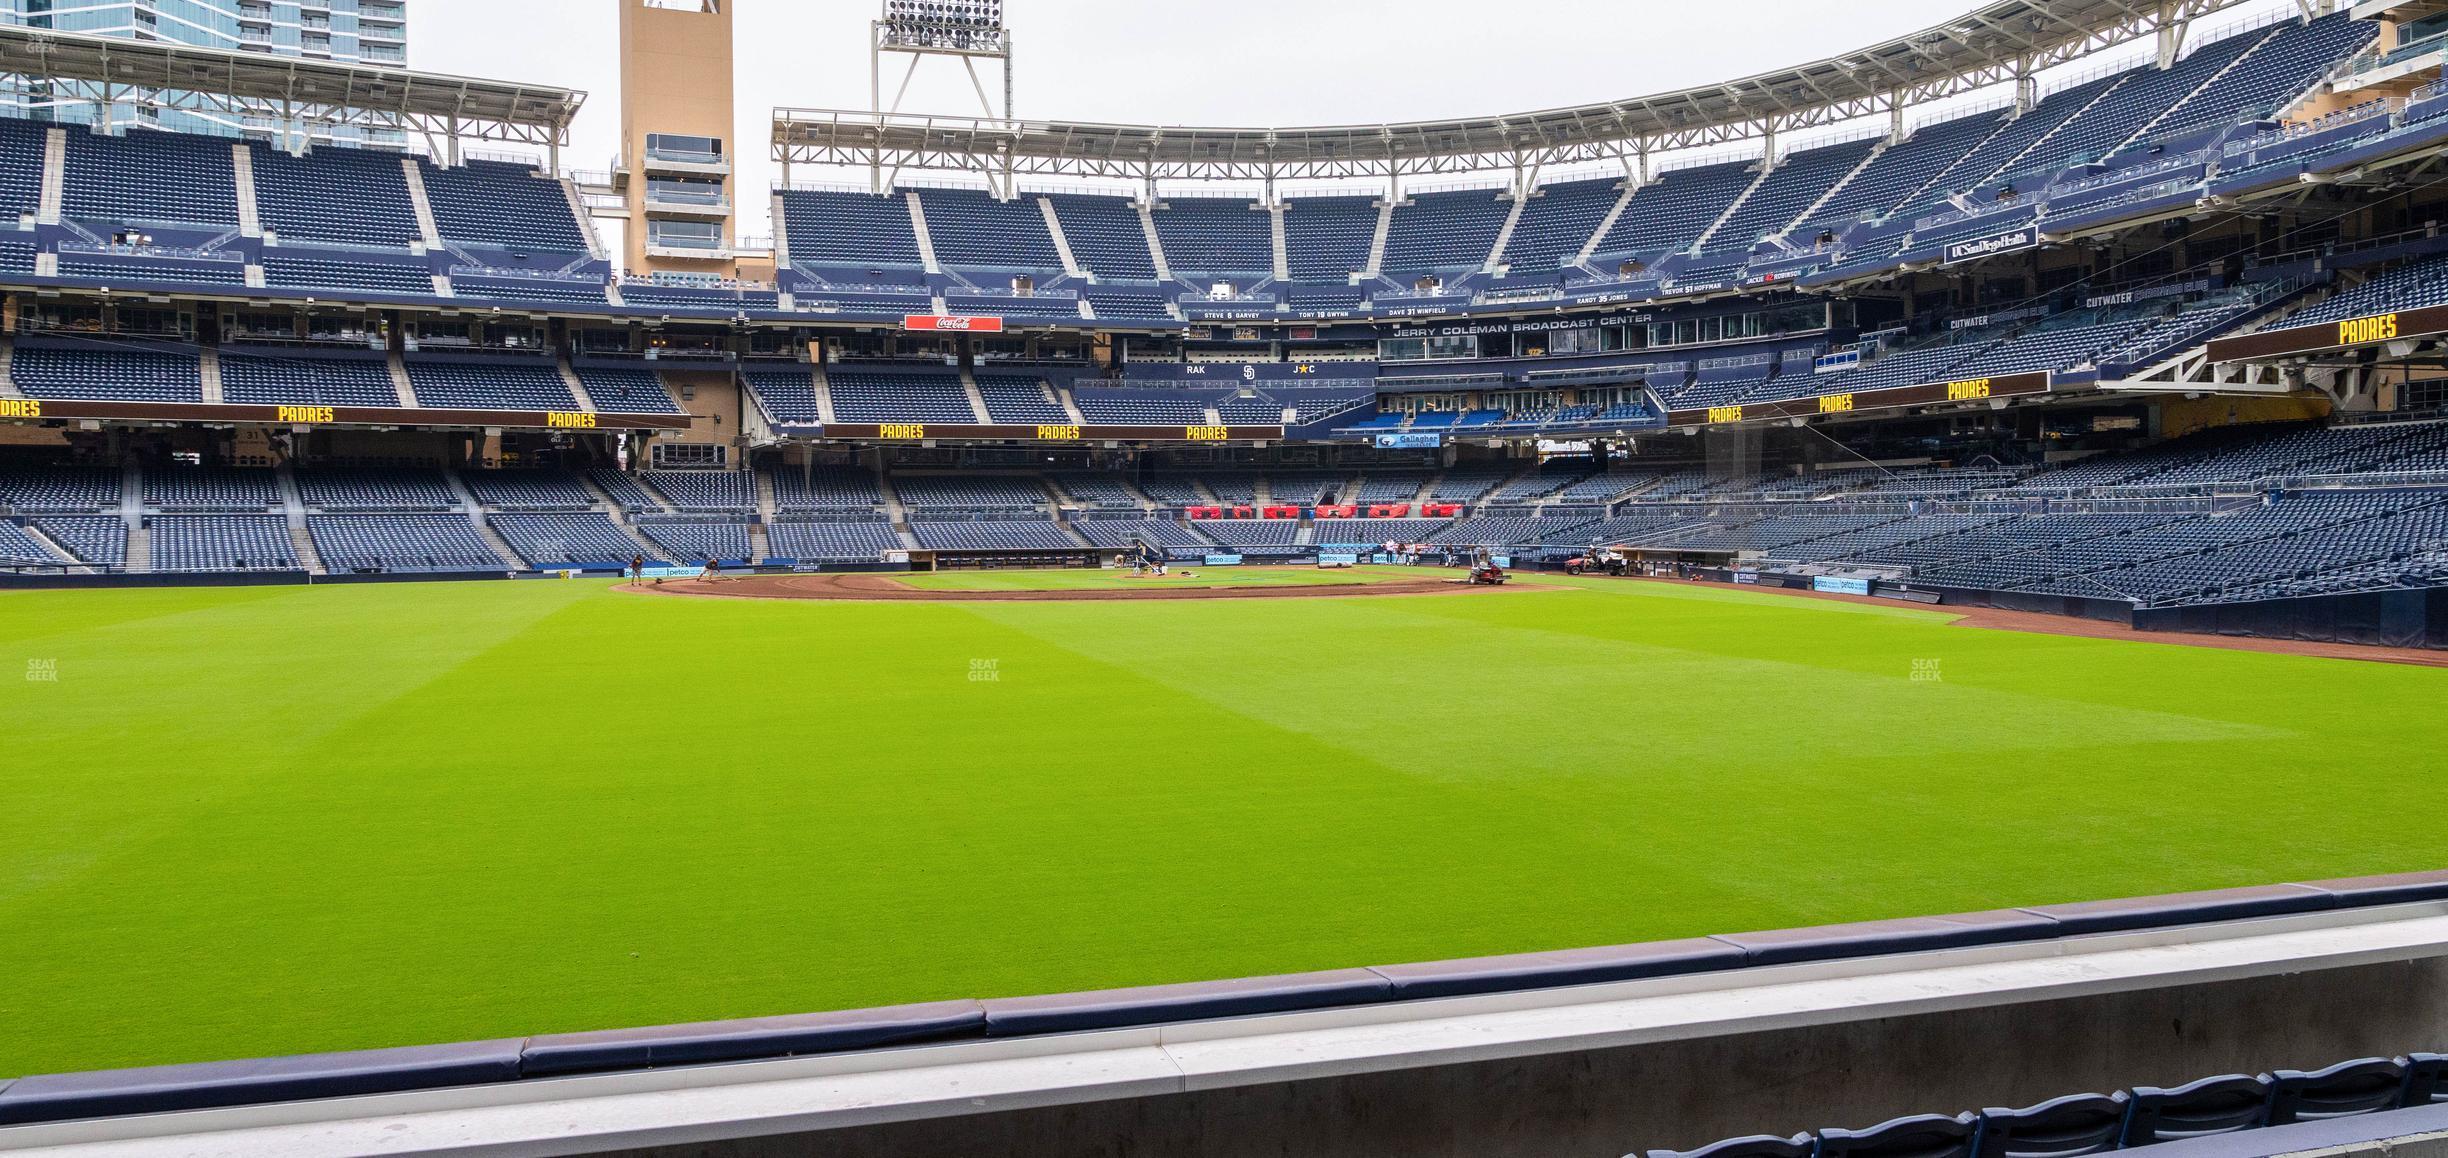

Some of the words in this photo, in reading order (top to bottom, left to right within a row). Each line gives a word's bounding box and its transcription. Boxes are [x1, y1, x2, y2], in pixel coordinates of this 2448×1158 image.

[2000, 233, 2027, 248] Health
[1774, 270, 1802, 280] ROBINSON
[1662, 288, 1684, 296] TREVOR
[1685, 286, 1693, 294] 51
[1694, 283, 1722, 292] HOFFMAN
[2086, 291, 2132, 308] CUTWATER
[936, 316, 971, 329] Coca-Cola
[1393, 327, 1436, 338] JERRY
[1442, 325, 1507, 335] COLEMAN
[1513, 318, 1595, 332] BROADCAST
[1600, 314, 1652, 326] CENTER
[1950, 315, 1988, 330] CUTWATER
[2339, 313, 2397, 345] PADRES
[1187, 366, 1205, 374] RAK
[1947, 379, 1989, 400] PADRES
[0, 400, 40, 417] DRES
[1818, 394, 1853, 413] PADRES
[278, 411, 334, 428] PADRES
[548, 411, 596, 428] PADRES
[1708, 406, 1742, 423] PADRES
[880, 424, 924, 439] PADRES
[1037, 425, 1080, 440] PADRES
[1187, 426, 1228, 441] PADRES
[1400, 435, 1438, 444] Gallagher
[669, 568, 690, 577] petco
